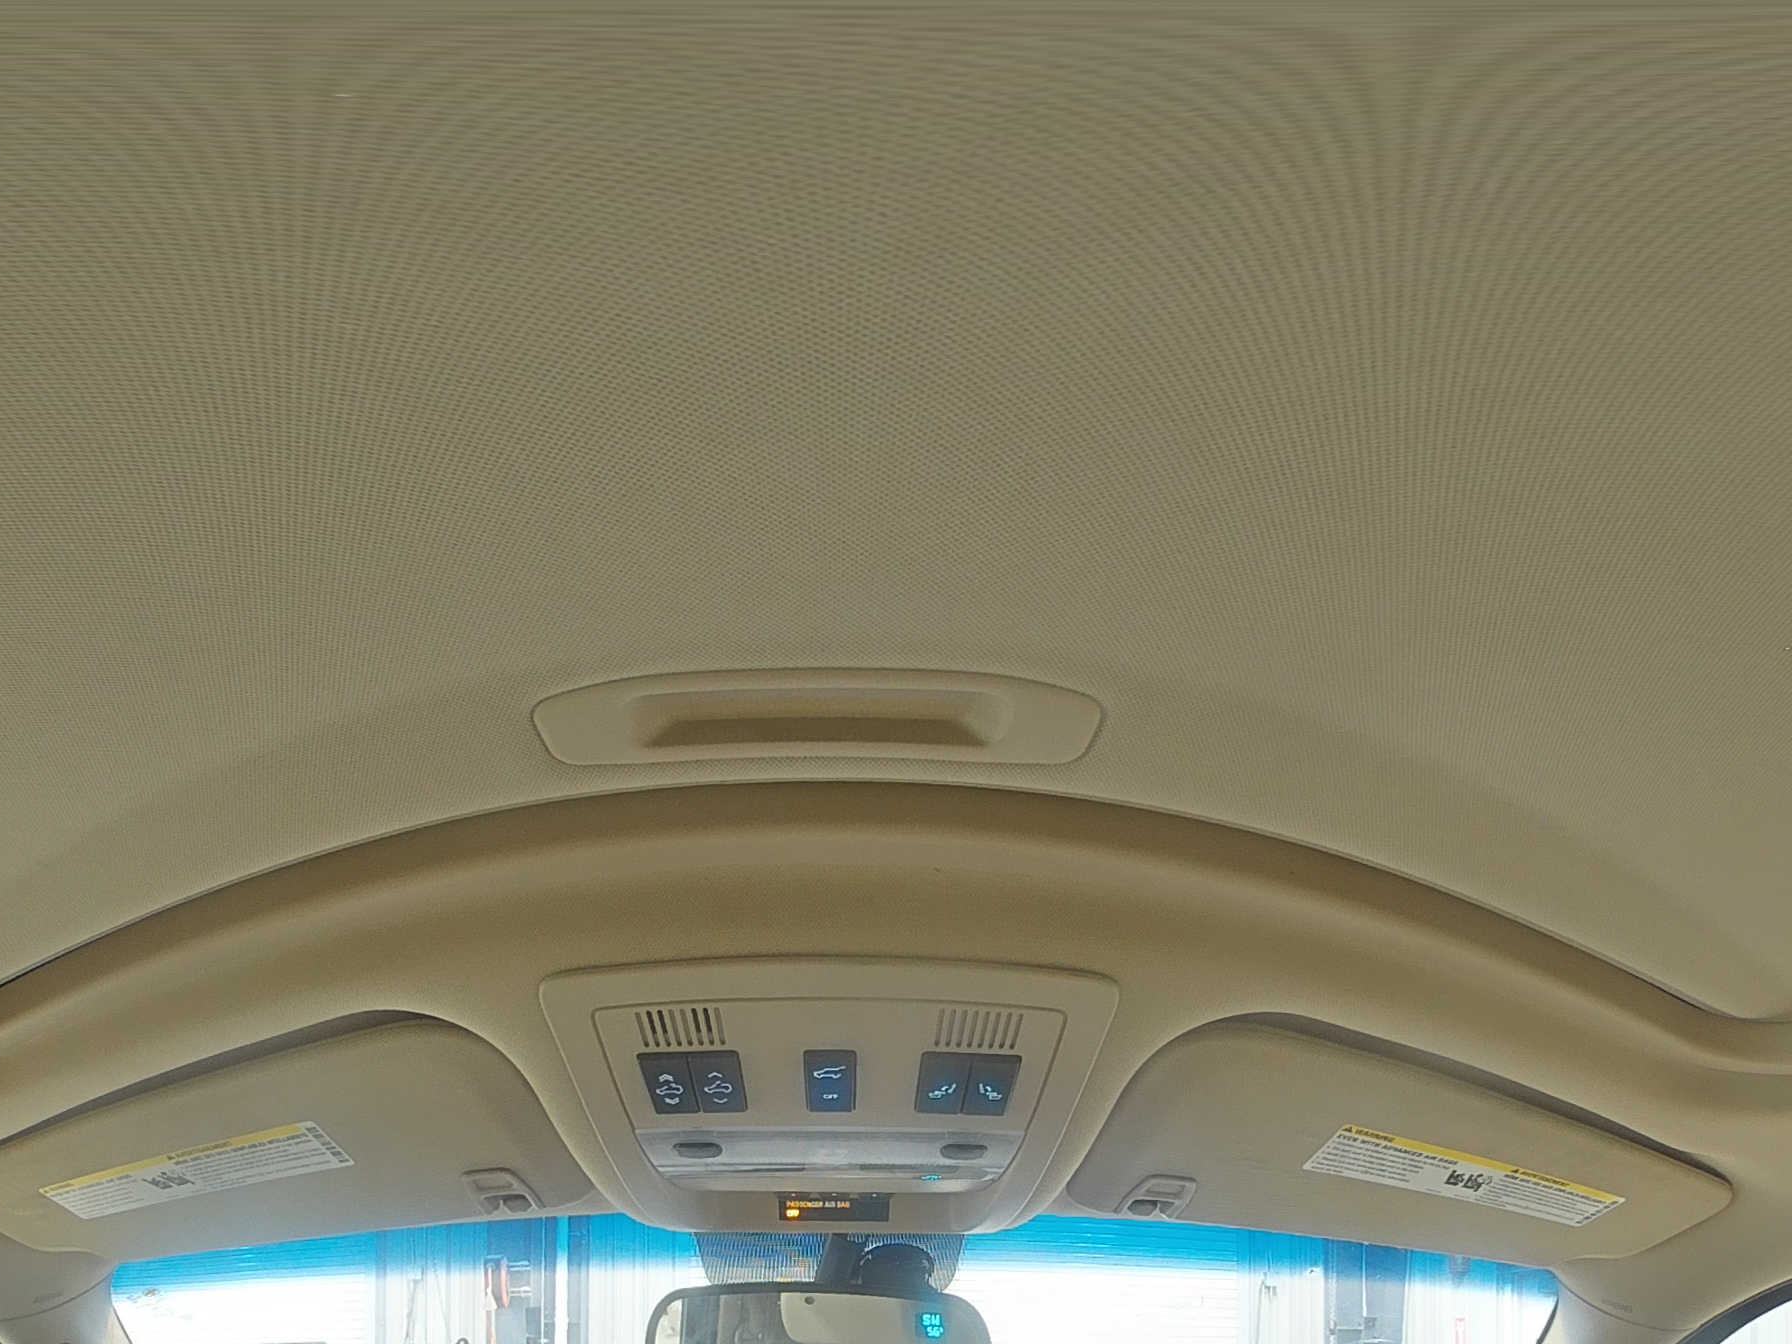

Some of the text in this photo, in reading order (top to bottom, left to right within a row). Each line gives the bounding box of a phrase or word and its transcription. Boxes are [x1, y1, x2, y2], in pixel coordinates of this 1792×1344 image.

[1336, 1133, 1359, 1143] EVEN
[1354, 1128, 1396, 1143] WARNING
[785, 1209, 800, 1217] OFF
